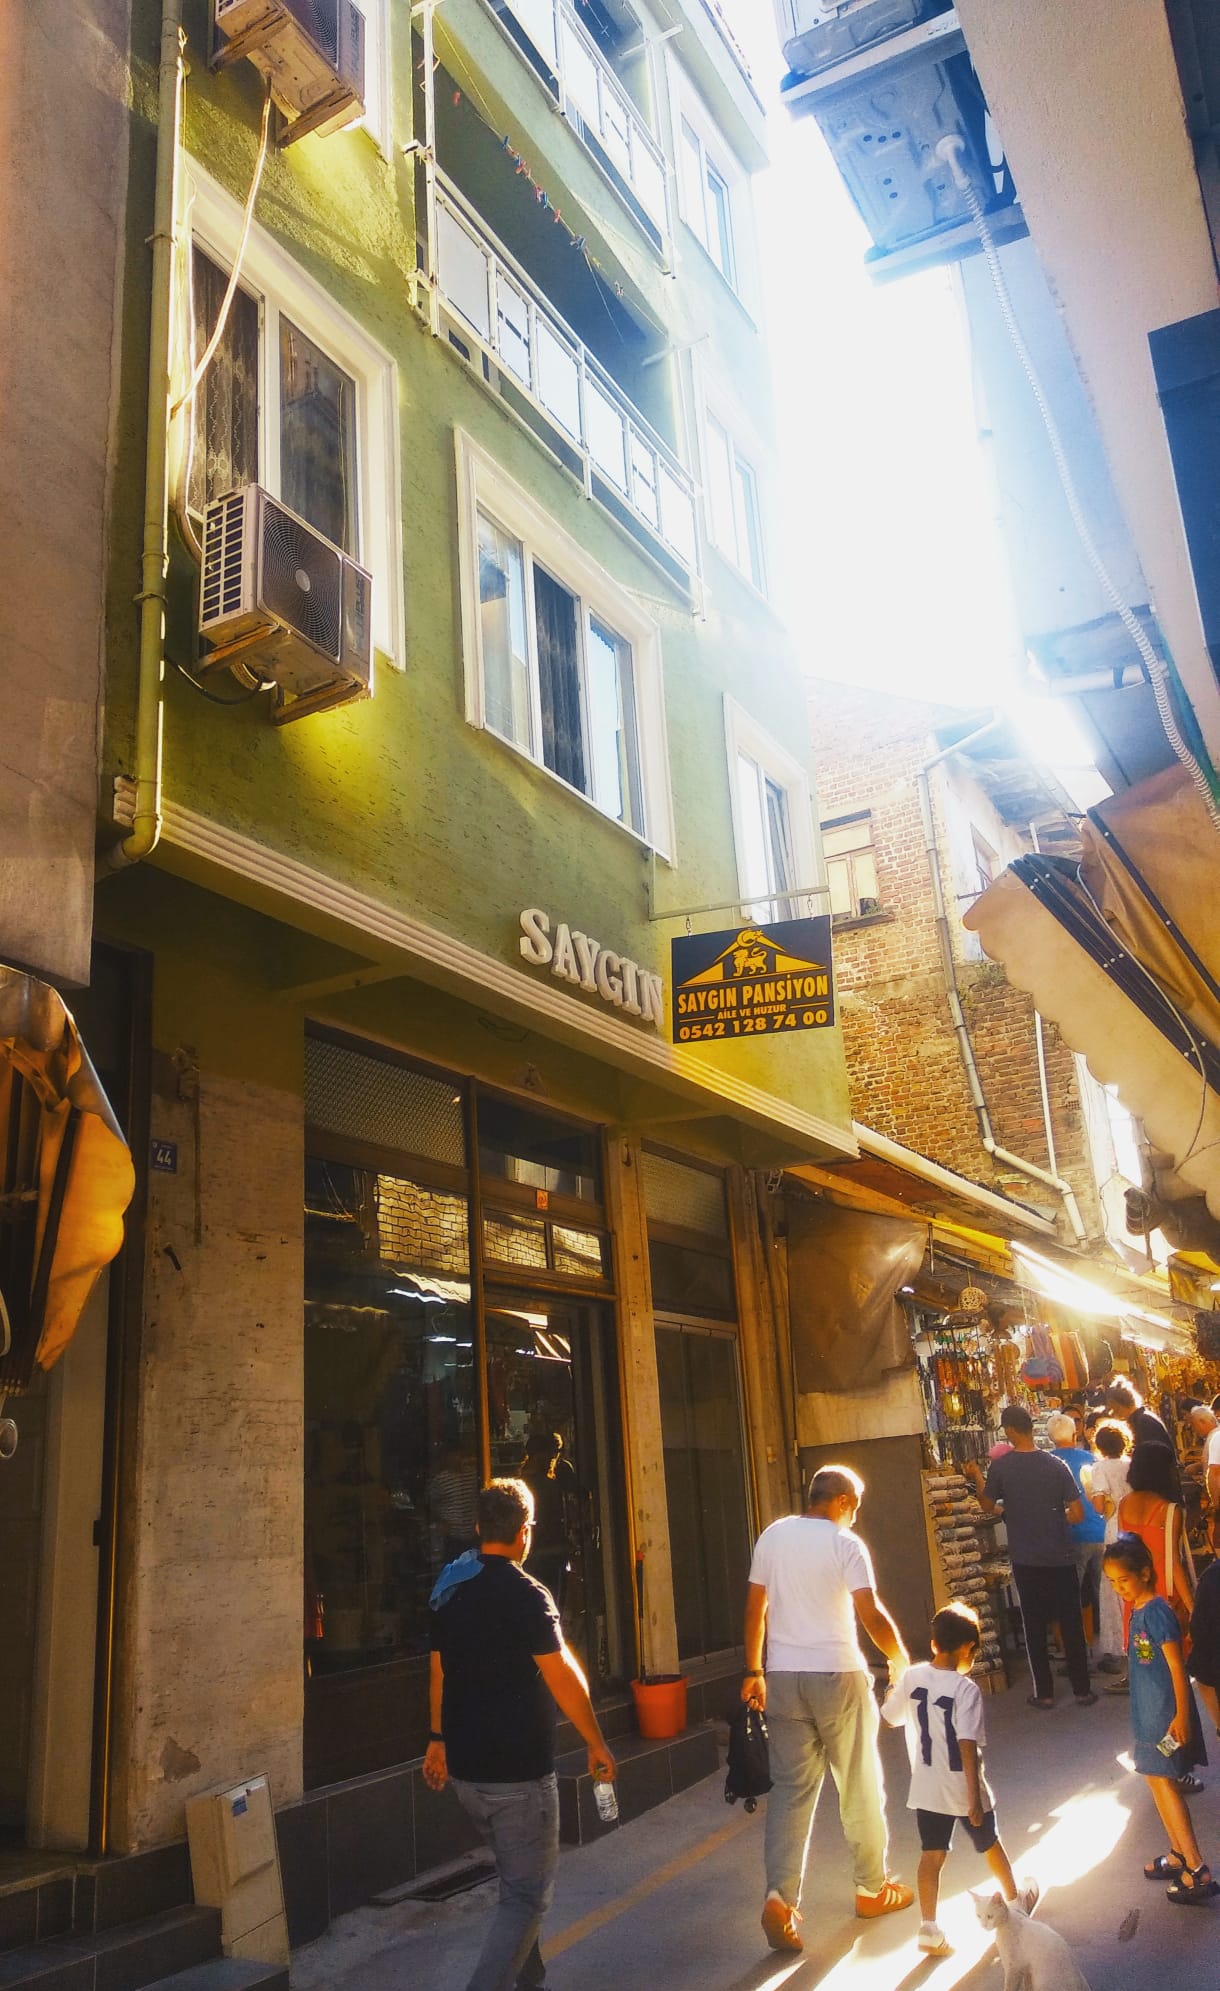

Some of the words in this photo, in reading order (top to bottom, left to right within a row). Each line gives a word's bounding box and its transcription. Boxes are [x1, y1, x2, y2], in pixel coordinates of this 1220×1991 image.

[519, 908, 664, 1028] SAYGIN
[678, 987, 737, 1014] SAYGIN
[742, 974, 828, 1006] PANSİYON
[679, 1022, 726, 1040] 0542
[733, 1017, 767, 1033] 128
[773, 1013, 797, 1029] 74
[802, 1009, 828, 1026] 00
[717, 1009, 737, 1020] AİLE
[739, 1008, 751, 1017] VE
[753, 1004, 787, 1016] HUZUR
[156, 1149, 171, 1165] 44
[909, 1686, 964, 1772] 11
